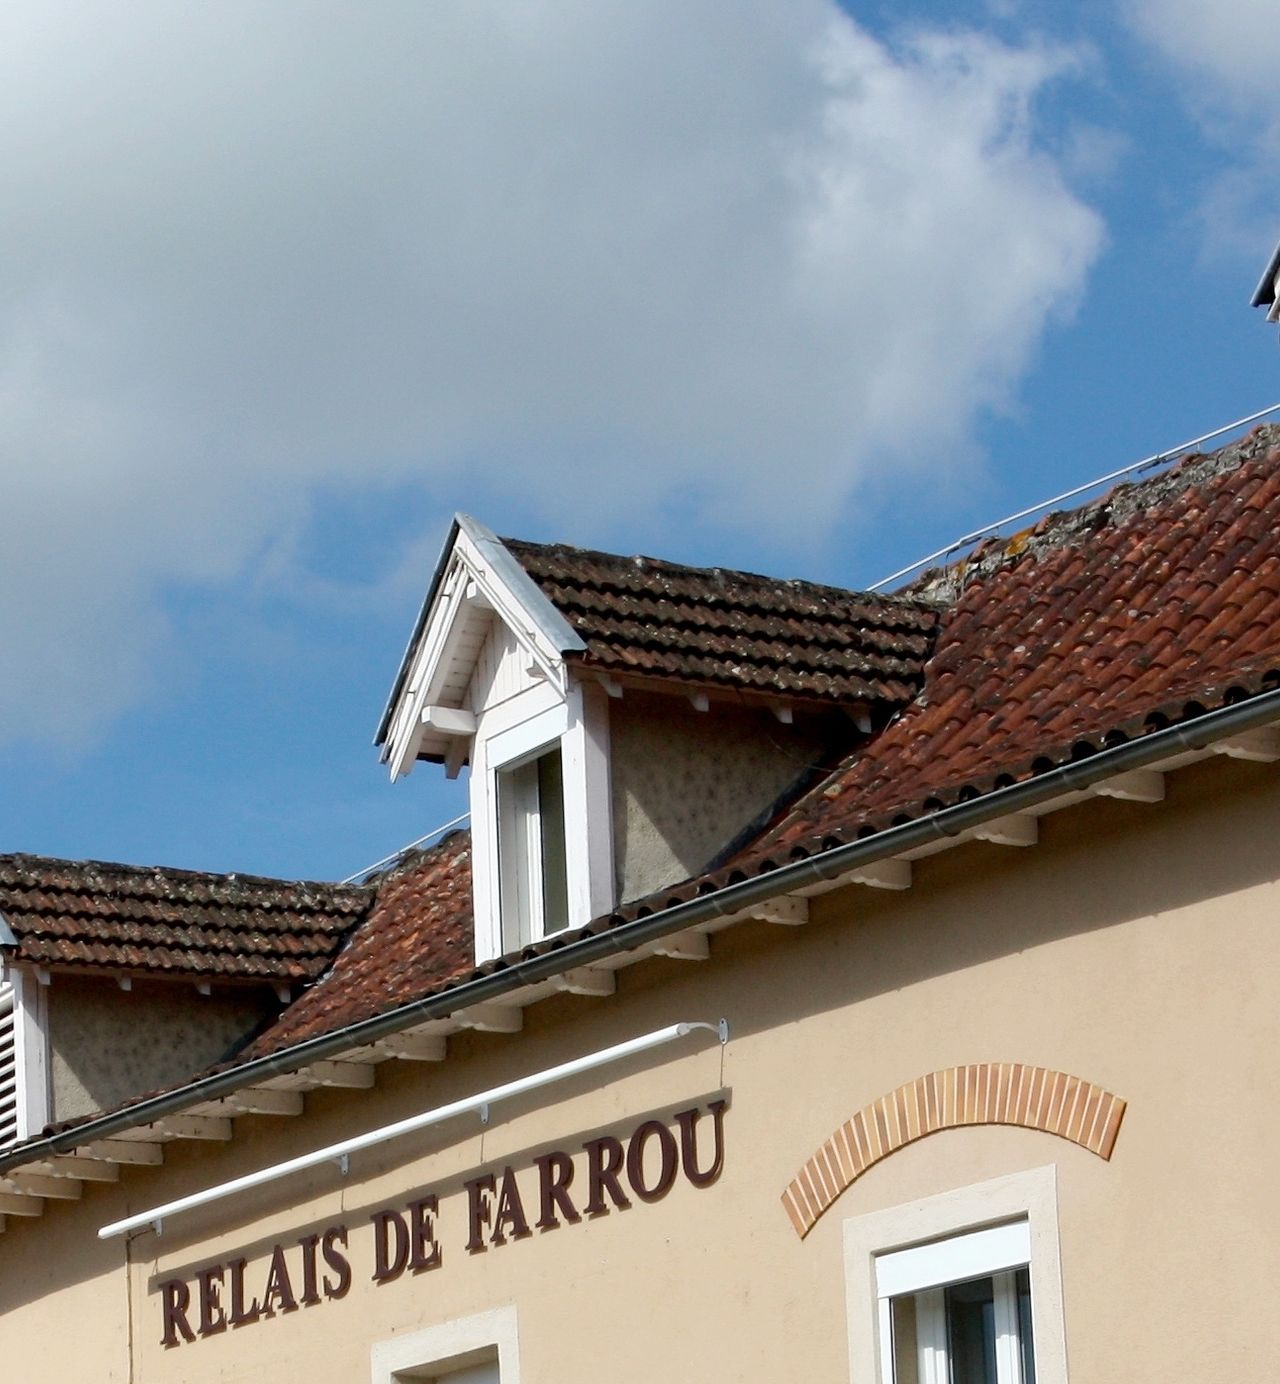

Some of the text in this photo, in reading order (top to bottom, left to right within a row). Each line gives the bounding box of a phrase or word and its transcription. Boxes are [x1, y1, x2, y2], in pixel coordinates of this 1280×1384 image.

[159, 1100, 730, 1350] RELAIS DE FARROU
